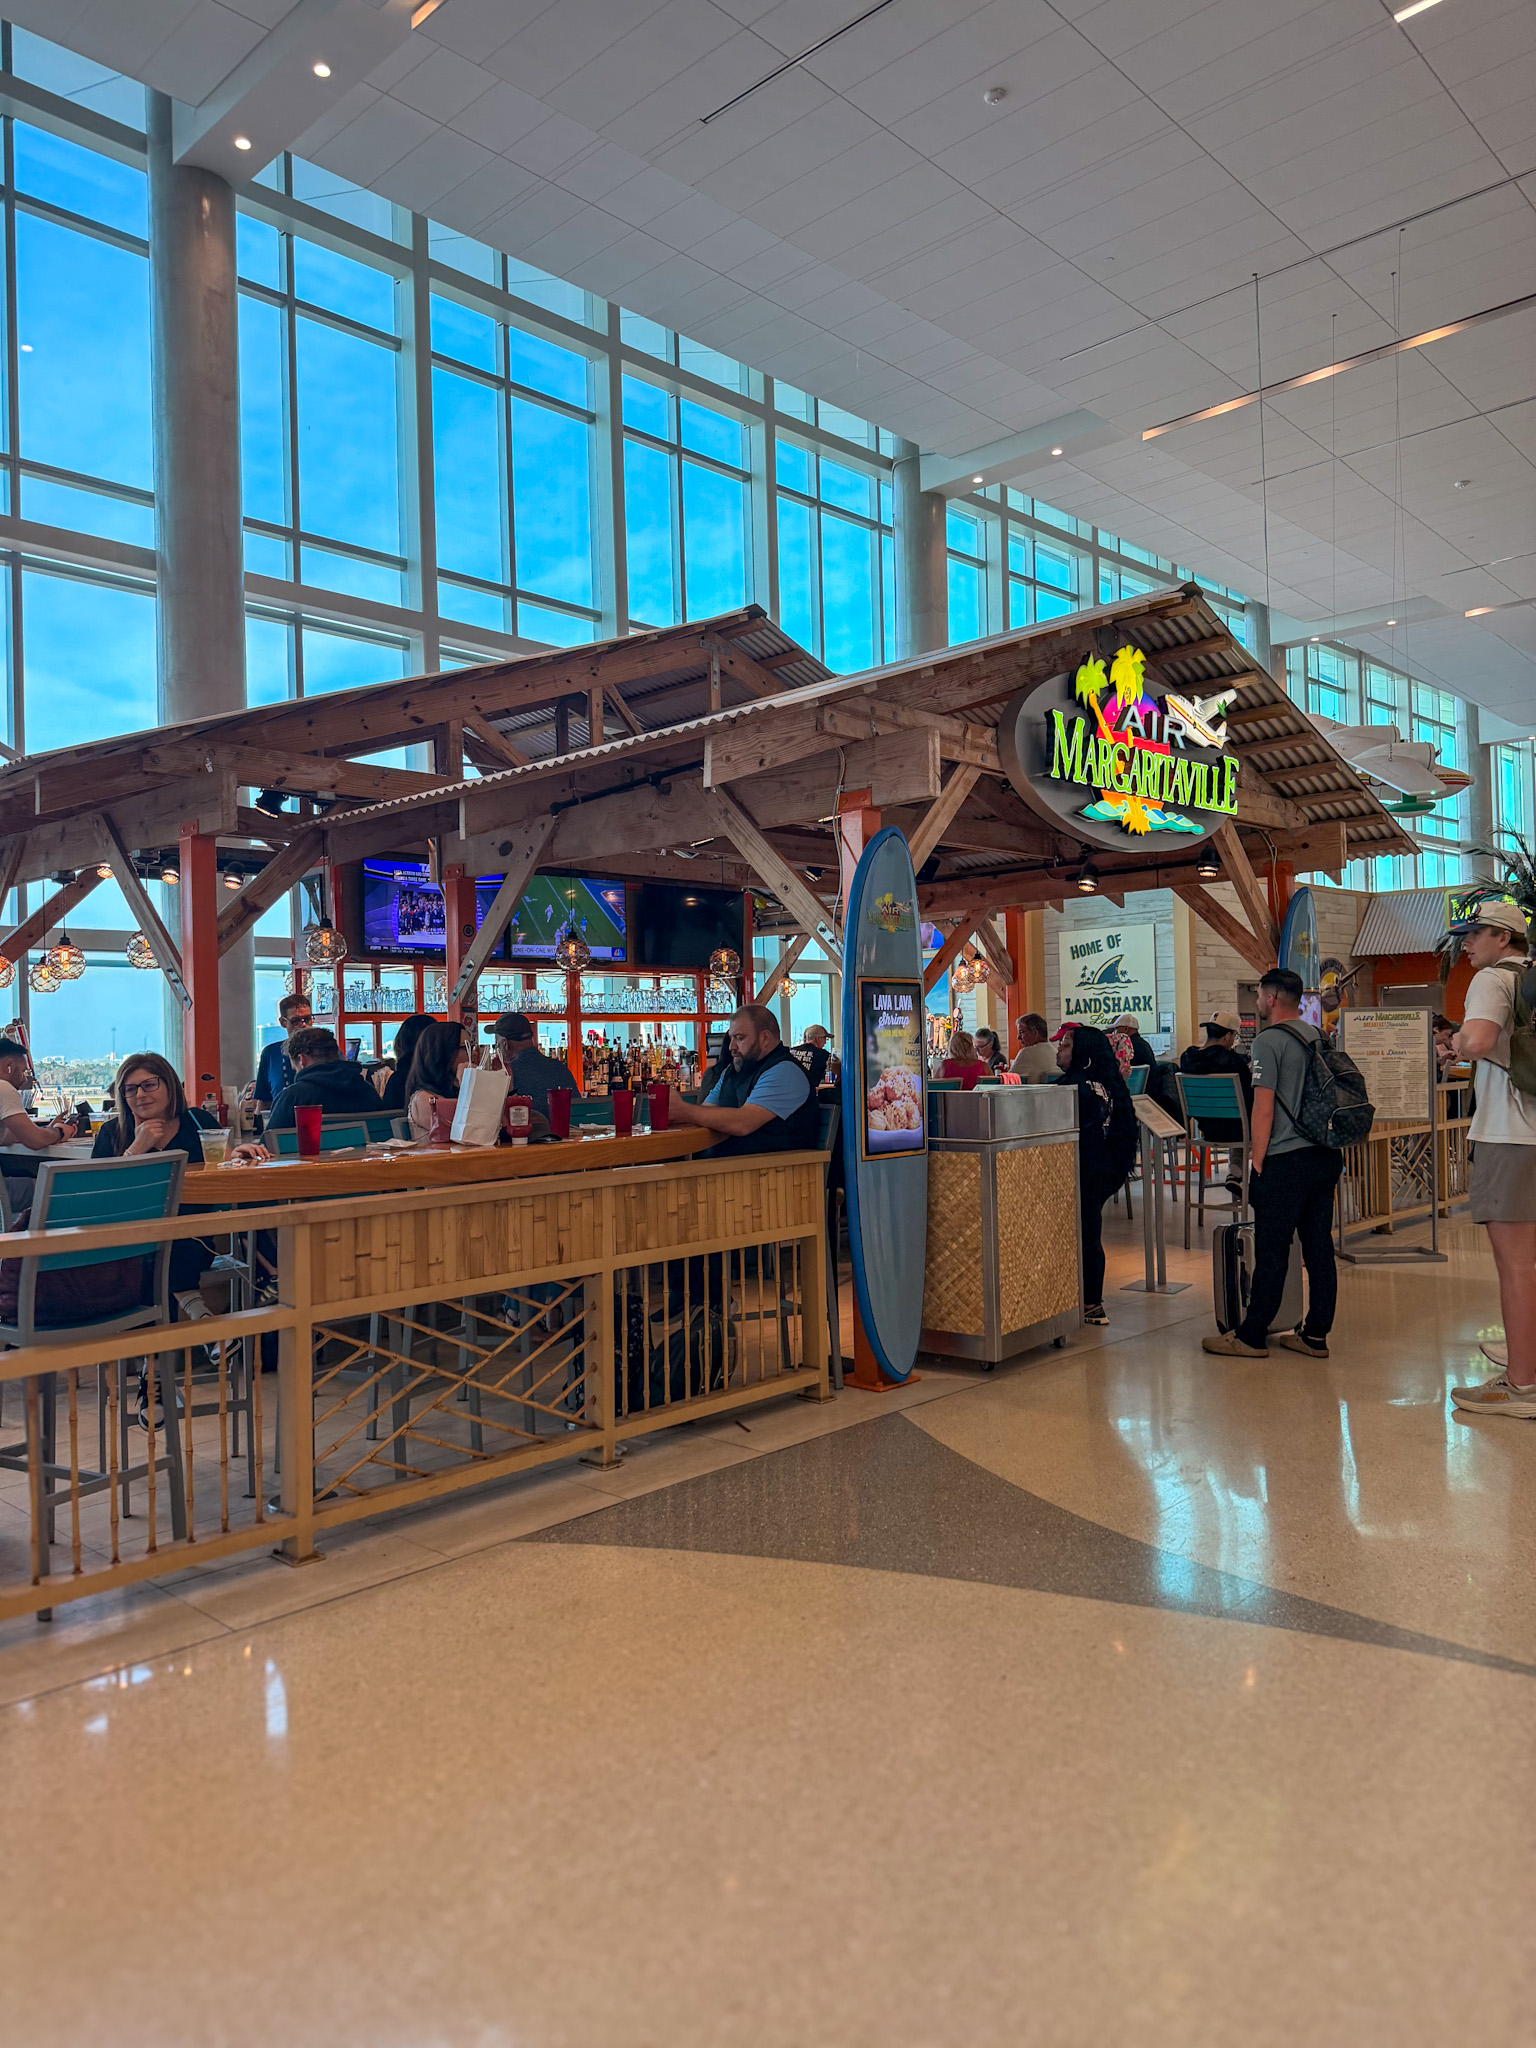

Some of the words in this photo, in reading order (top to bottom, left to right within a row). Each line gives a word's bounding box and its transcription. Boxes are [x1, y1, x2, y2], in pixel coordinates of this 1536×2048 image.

[1120, 705, 1187, 750] AIR
[1051, 709, 1239, 815] MARGARITAVILLE
[881, 905, 900, 915] AIR
[1070, 939, 1103, 960] HOME
[1107, 933, 1122, 949] OF
[873, 994, 893, 1011] LAVA
[894, 995, 913, 1011] LAVA
[1065, 995, 1153, 1016] LANDSHARK
[878, 1011, 910, 1028] Shrimp
